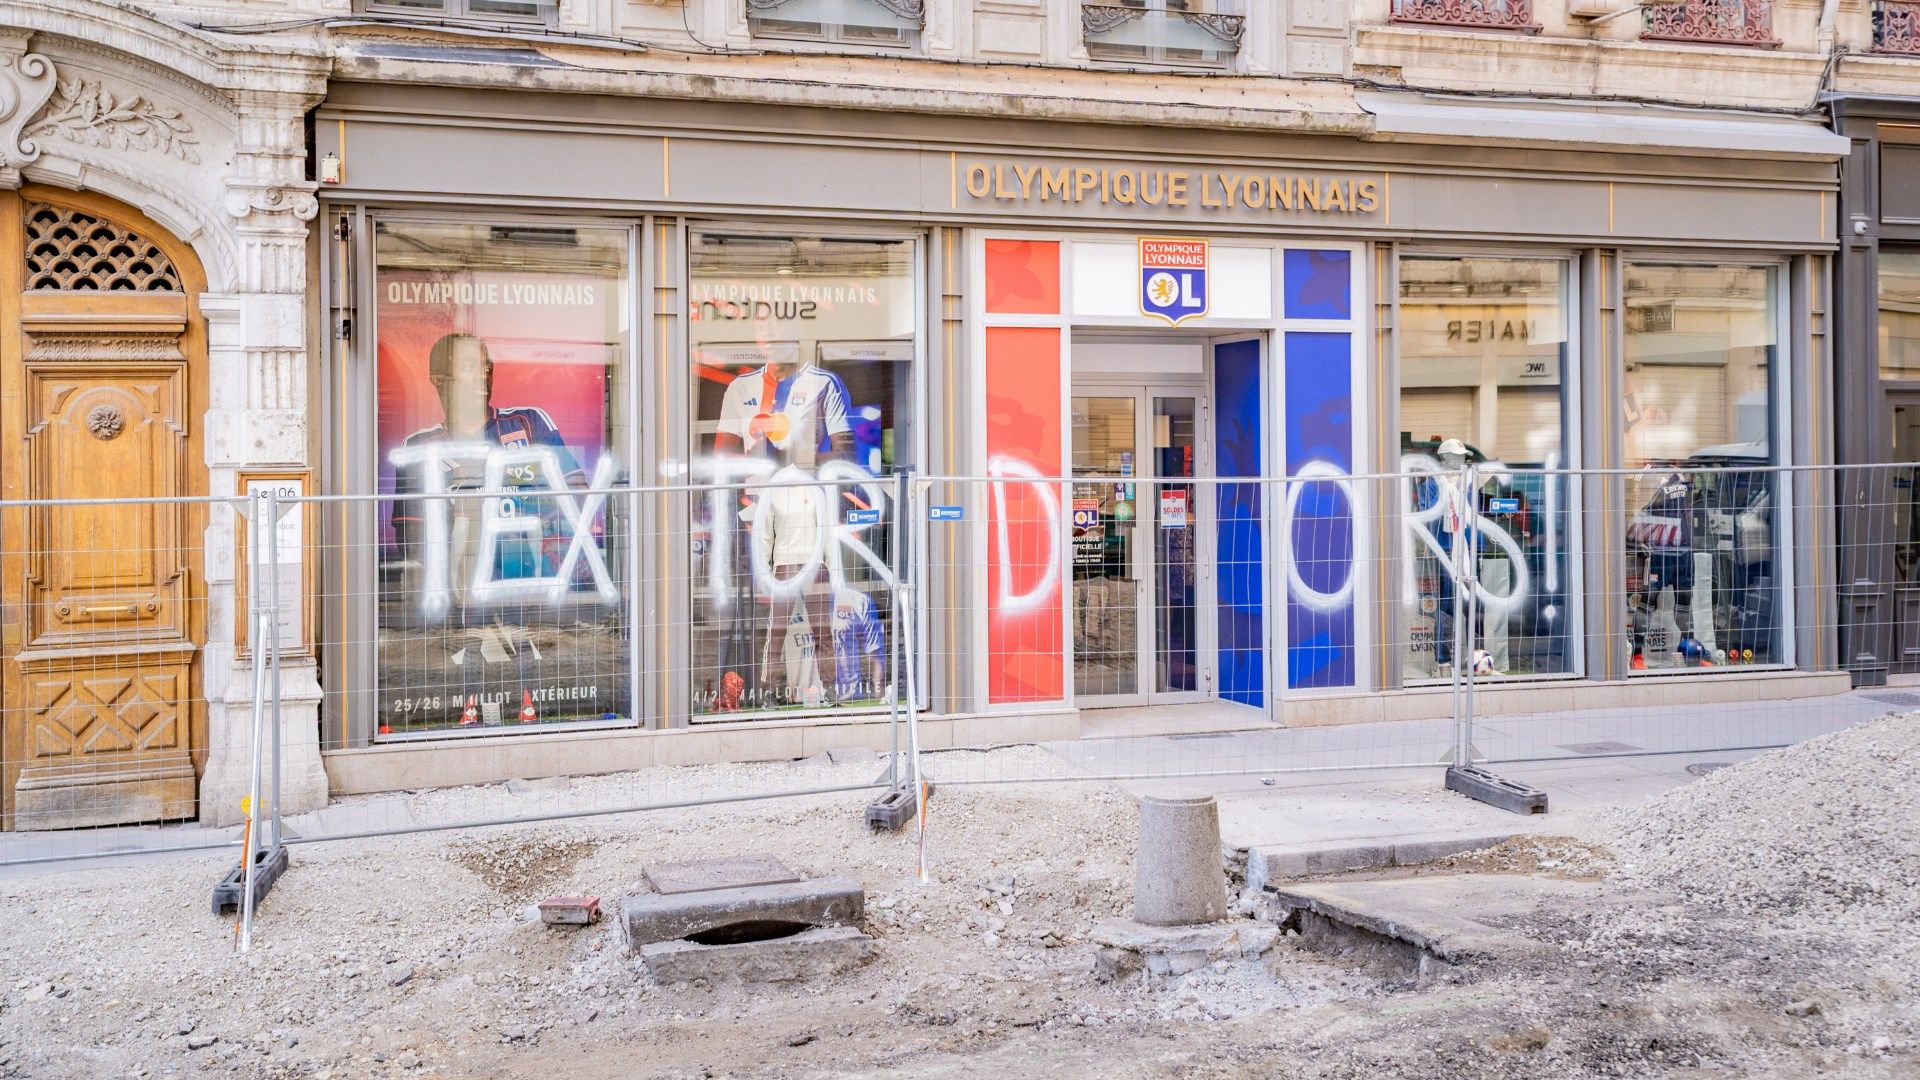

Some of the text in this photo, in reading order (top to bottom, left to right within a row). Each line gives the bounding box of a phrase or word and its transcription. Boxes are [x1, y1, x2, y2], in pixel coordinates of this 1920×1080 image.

[965, 163, 1380, 212] OLYMPIQUE LYONNAIS
[1145, 243, 1203, 254] OLYMPIQUE
[1145, 254, 1203, 265] LYONNAIS
[387, 281, 596, 306] OLYMPIQUE LYONNAIS
[692, 285, 876, 304] LYMPIQUE LYONNAIS
[273, 487, 296, 498] 06
[394, 685, 598, 713] 25/26 MILLOT XTÉRIEUR
